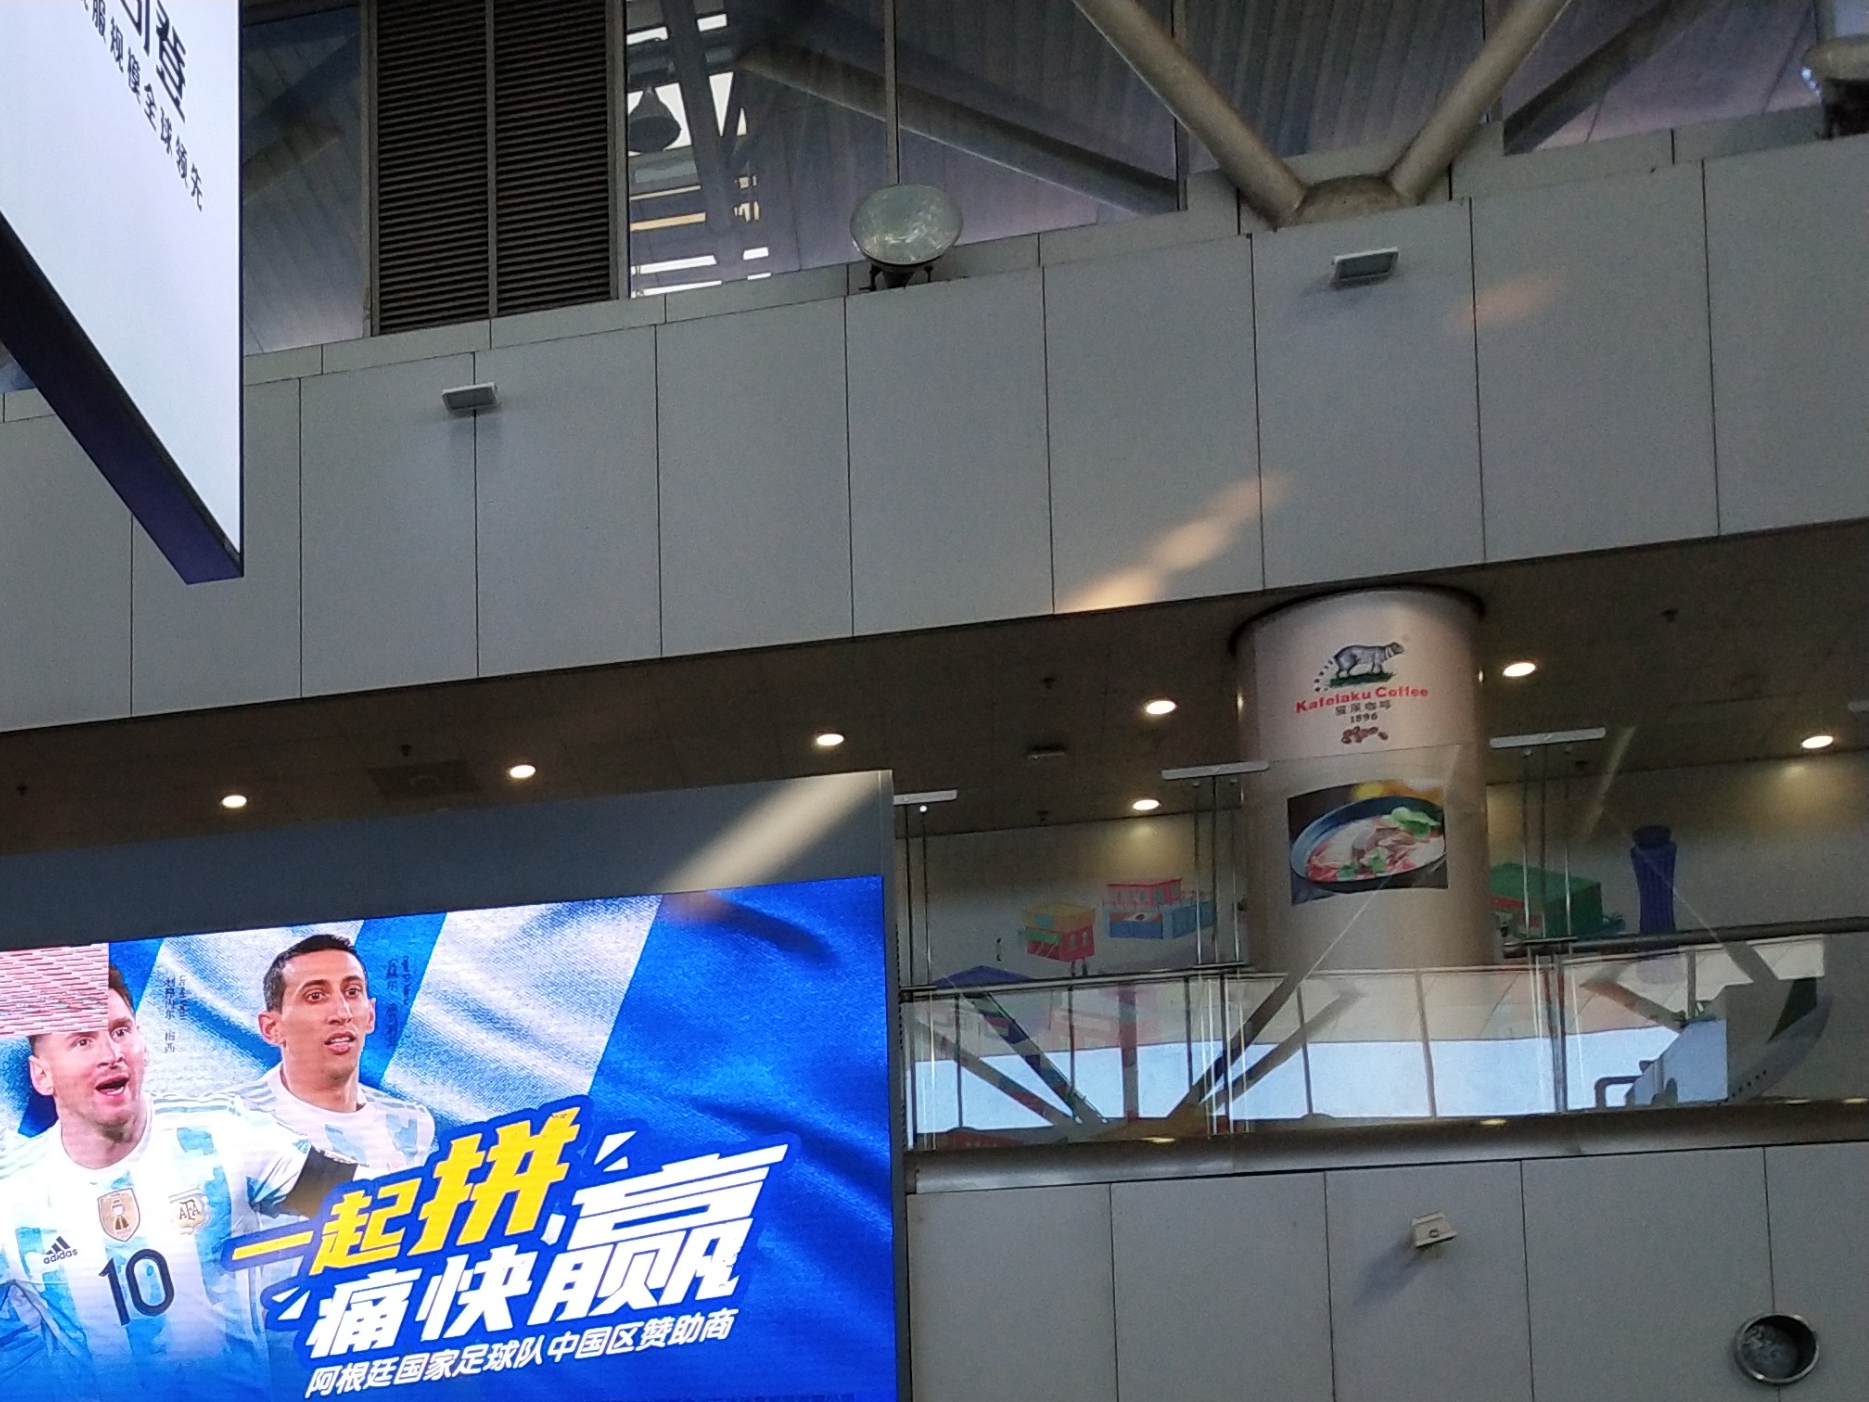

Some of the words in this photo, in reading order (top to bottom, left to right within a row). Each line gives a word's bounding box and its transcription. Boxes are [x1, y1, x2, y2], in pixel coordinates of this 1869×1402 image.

[83, 0, 202, 212] 服规模全球领先
[1295, 690, 1371, 714] Kafelaku
[1376, 686, 1429, 698] Coffee
[231, 1107, 581, 1276] 一起拼
[43, 1248, 79, 1265] adidas
[98, 1248, 174, 1327] 10
[305, 1143, 788, 1360] 痛快赢
[304, 1308, 738, 1399] 阿根廷国家足球队中国区赞助商
